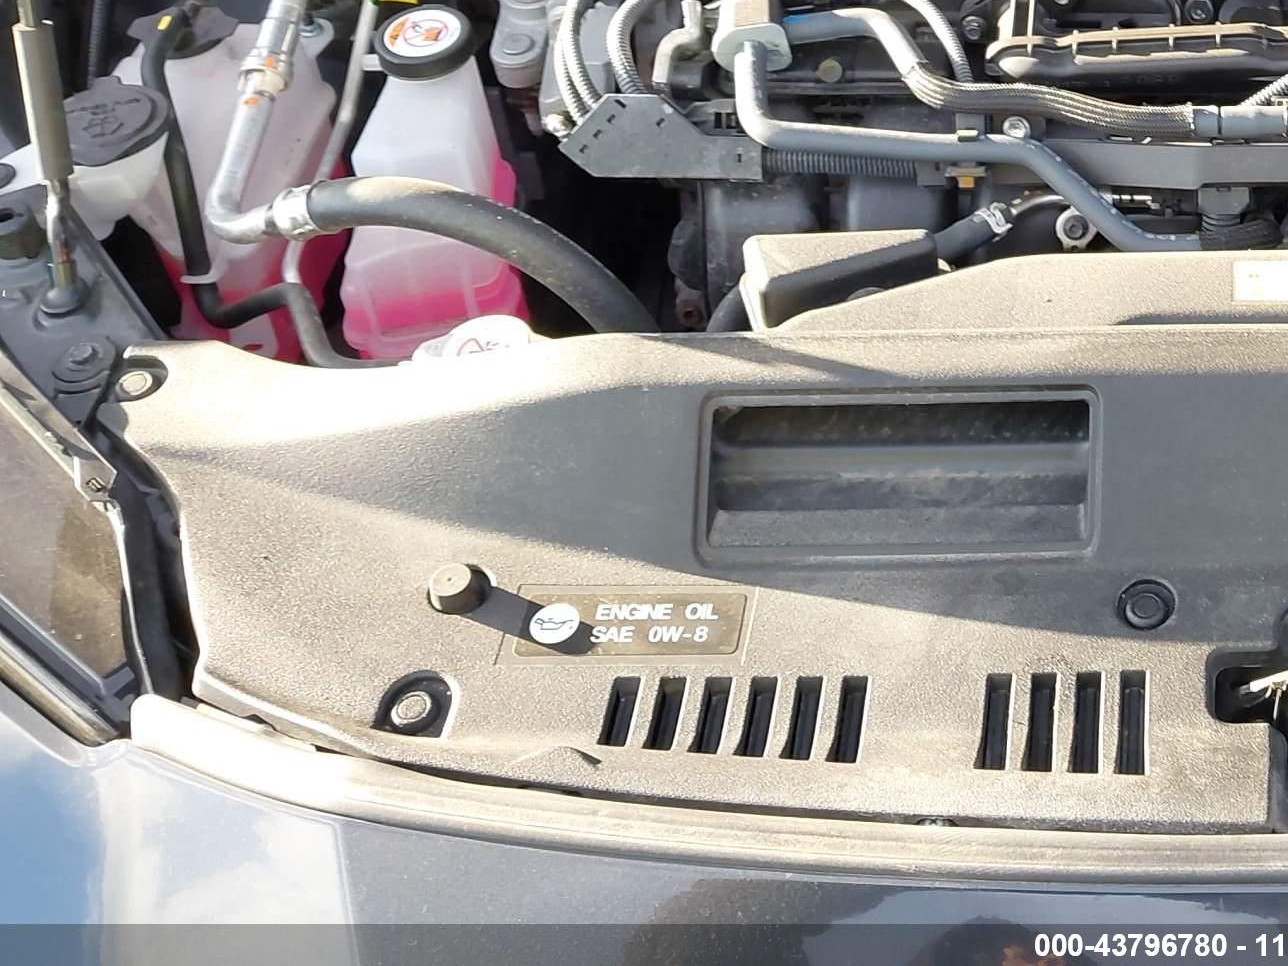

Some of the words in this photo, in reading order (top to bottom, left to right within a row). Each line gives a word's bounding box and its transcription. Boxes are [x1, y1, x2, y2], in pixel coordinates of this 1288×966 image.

[595, 603, 674, 620] ENGINE
[685, 603, 719, 620] OIL
[590, 625, 636, 643] SAE
[648, 625, 709, 643] 0W-8
